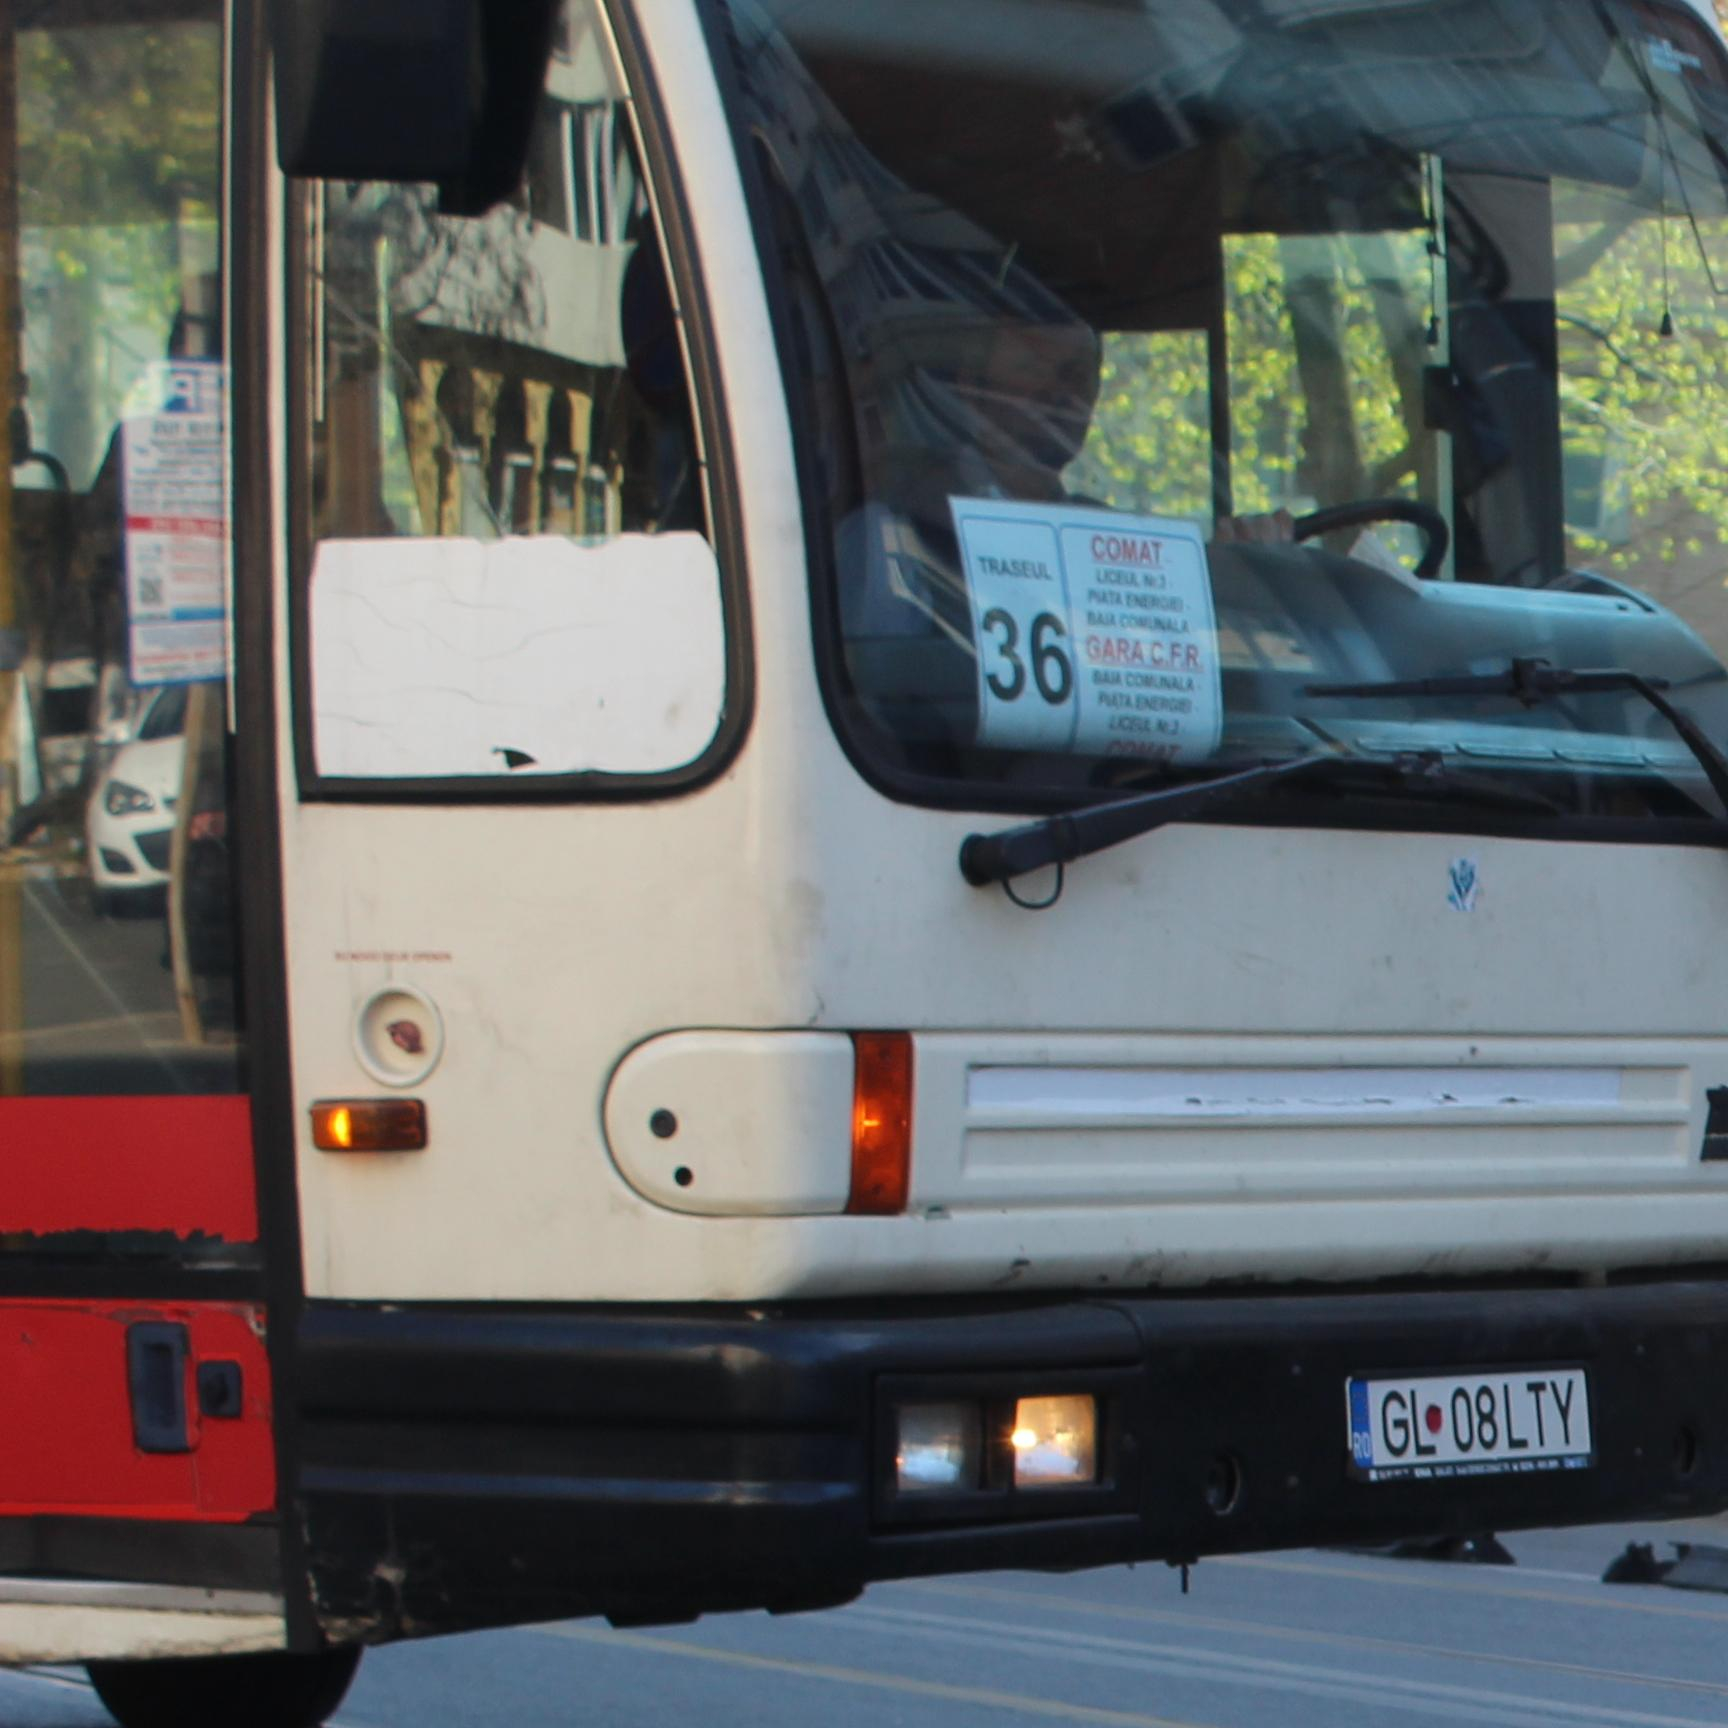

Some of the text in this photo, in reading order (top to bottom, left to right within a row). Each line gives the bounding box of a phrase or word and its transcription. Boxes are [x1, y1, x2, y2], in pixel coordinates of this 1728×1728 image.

[1090, 534, 1163, 564] COMAT
[977, 556, 1053, 582] TRASEUL
[1119, 612, 1190, 634] COMUNALA
[981, 607, 1074, 706] 36
[1085, 634, 1145, 663] GARA
[1125, 669, 1195, 692] COMUNALA
[1381, 1389, 1437, 1458] GL
[1353, 1432, 1372, 1458] RO
